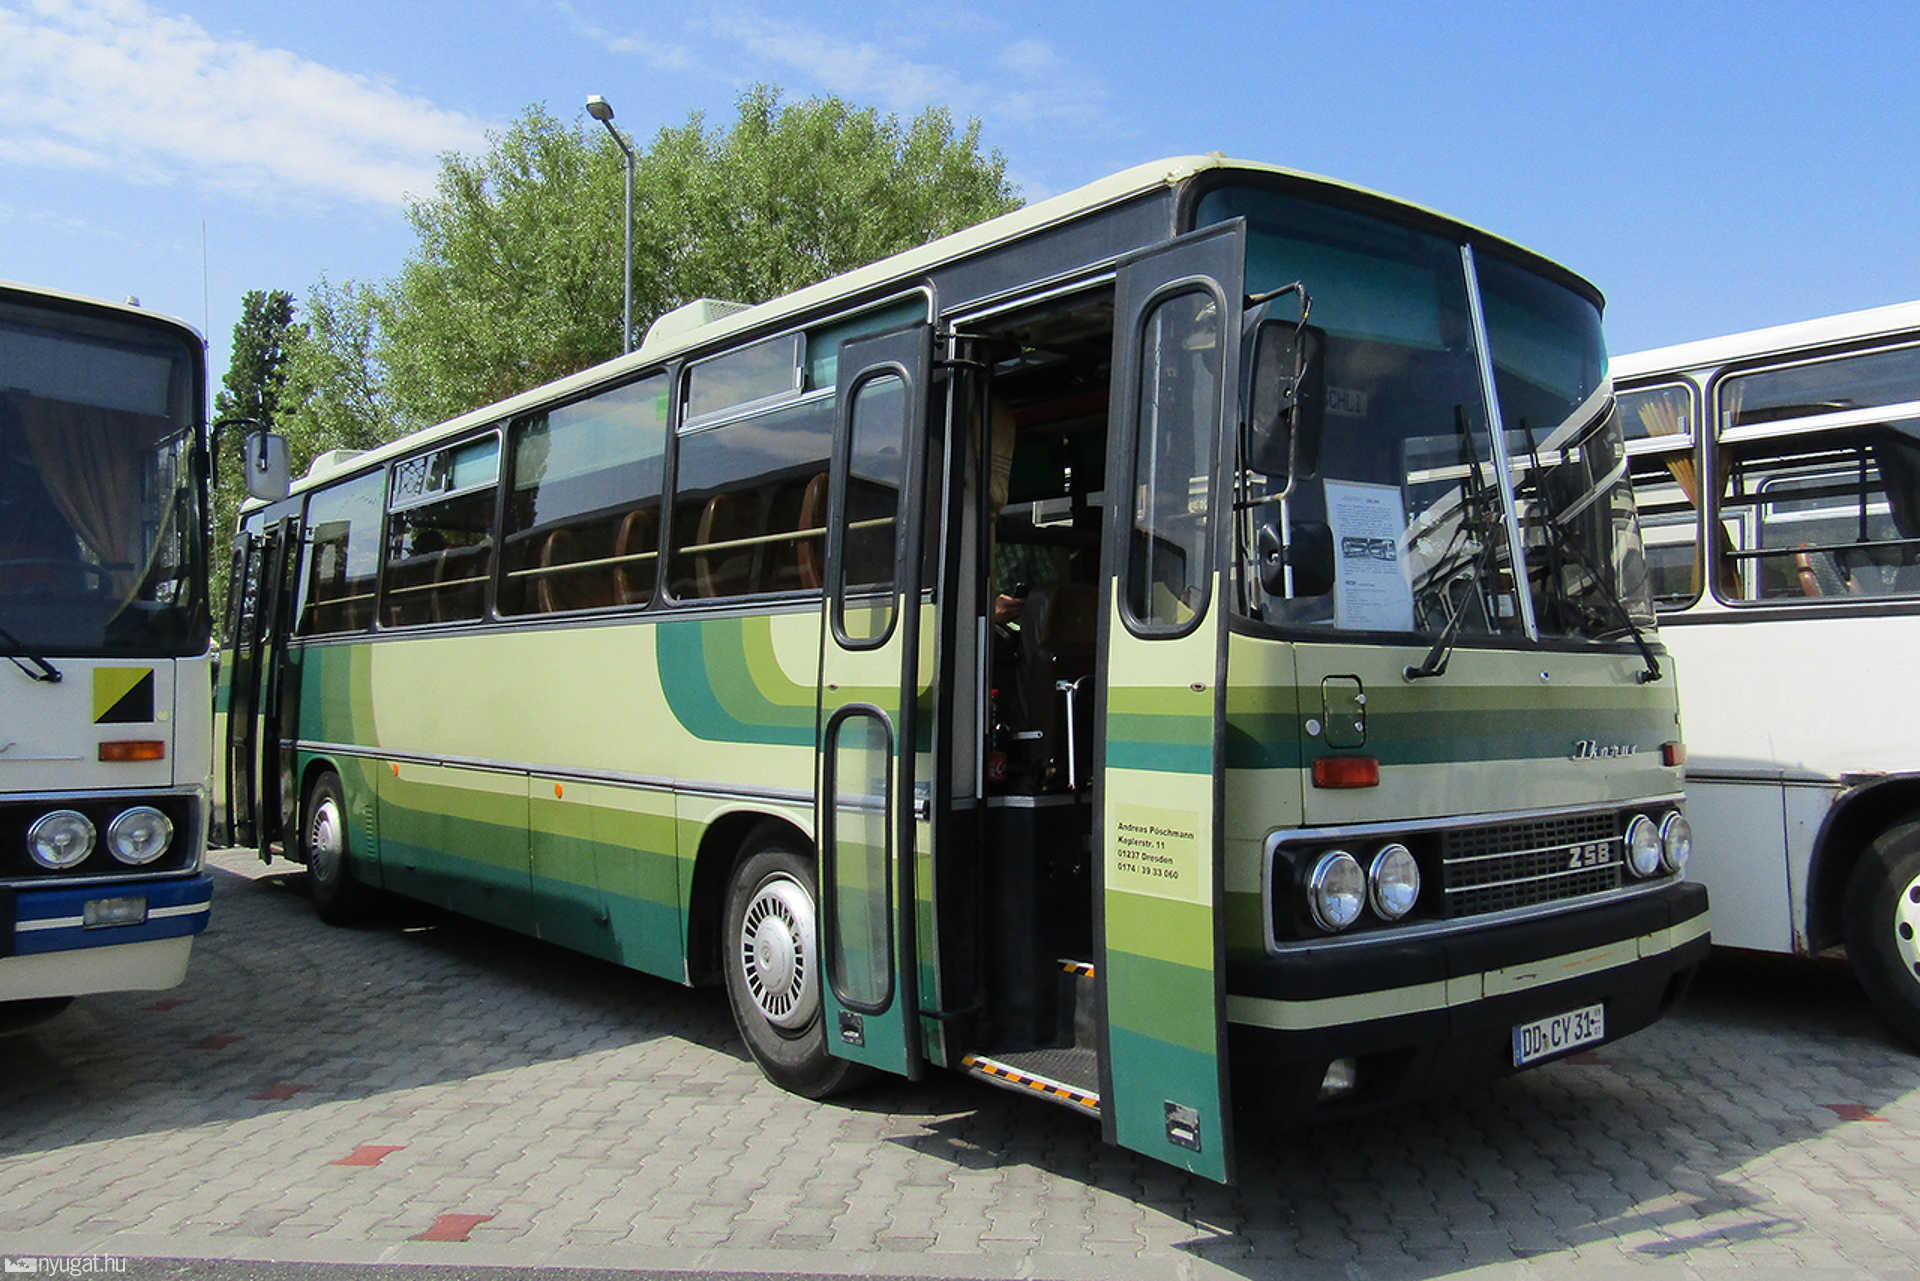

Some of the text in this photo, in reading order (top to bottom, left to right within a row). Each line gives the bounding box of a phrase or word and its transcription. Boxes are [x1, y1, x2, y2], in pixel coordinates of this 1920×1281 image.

[1117, 822, 1195, 839] Andreas Pöschmann
[1156, 840, 1165, 849] 11
[1117, 849, 1174, 864] 01237 Dresden
[1117, 862, 1136, 873] 0174
[1522, 1011, 1592, 1057] DD CY 31
